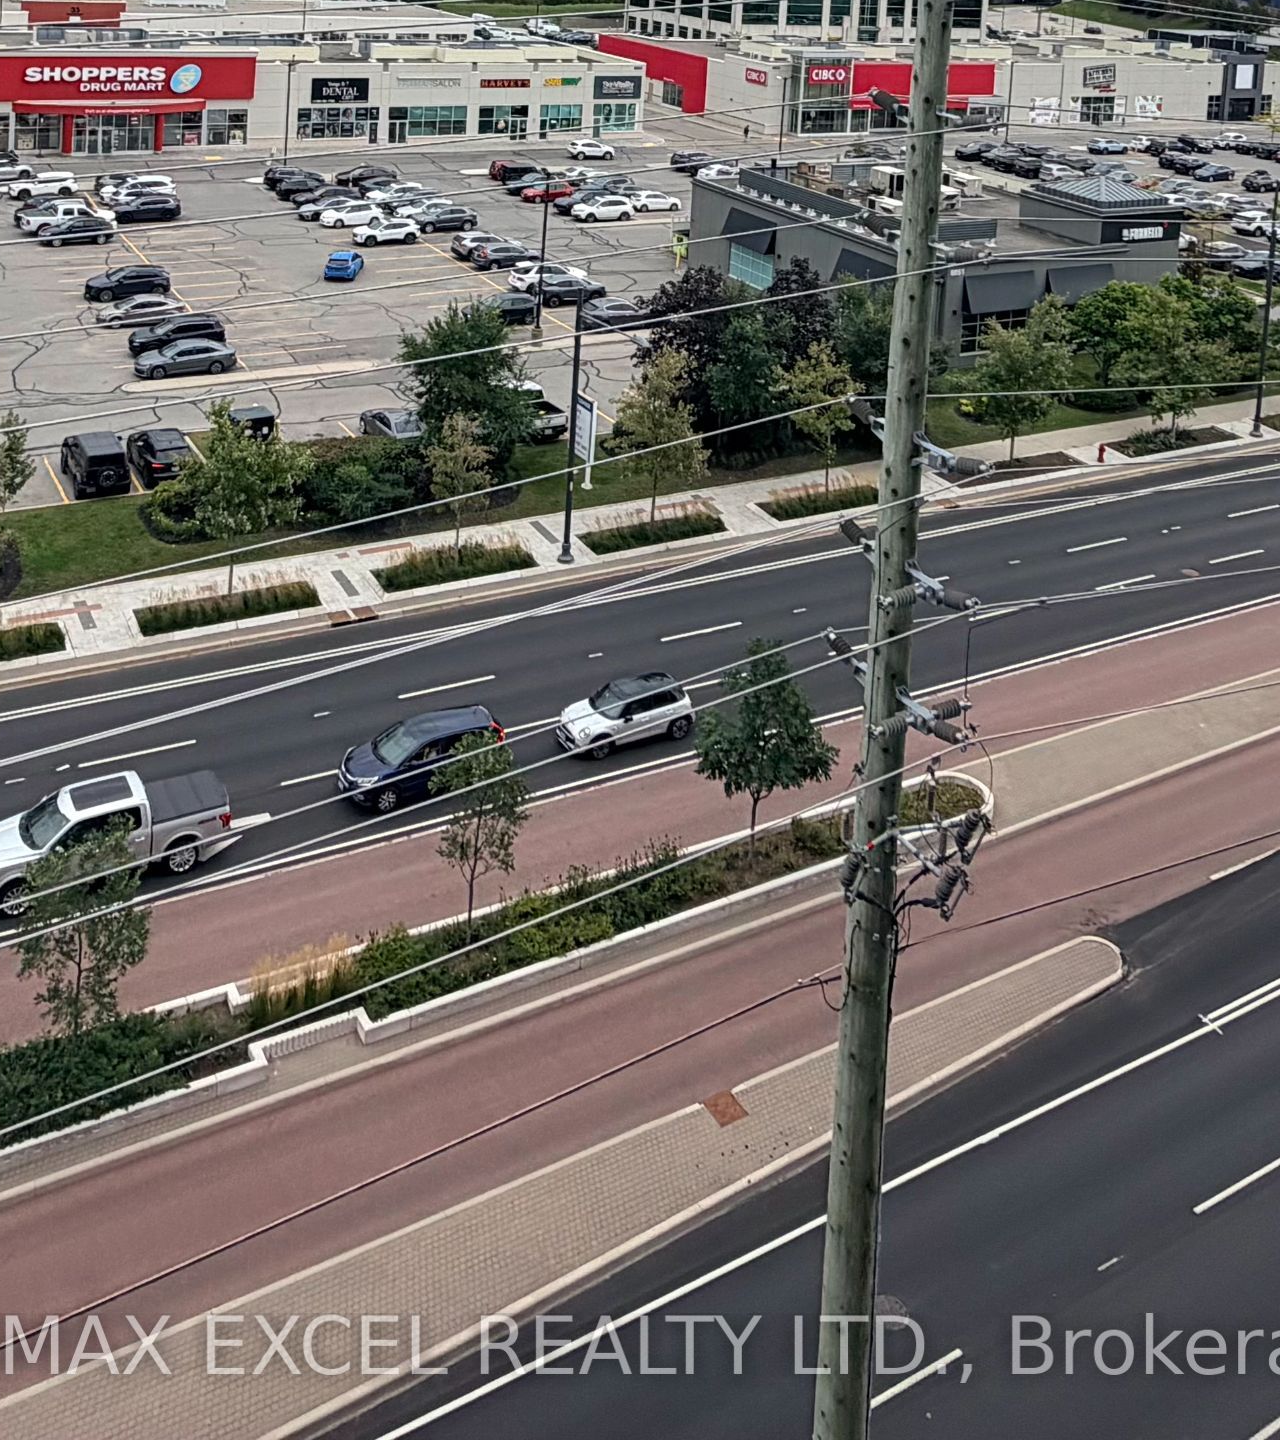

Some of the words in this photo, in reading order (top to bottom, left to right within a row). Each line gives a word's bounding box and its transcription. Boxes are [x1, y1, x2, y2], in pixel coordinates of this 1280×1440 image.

[24, 66, 166, 82] SHOPPERS
[812, 69, 835, 80] CIBC
[79, 82, 121, 92] DRUG
[124, 81, 165, 92] MART
[432, 79, 461, 88] SALON
[322, 87, 360, 96] DENTAL
